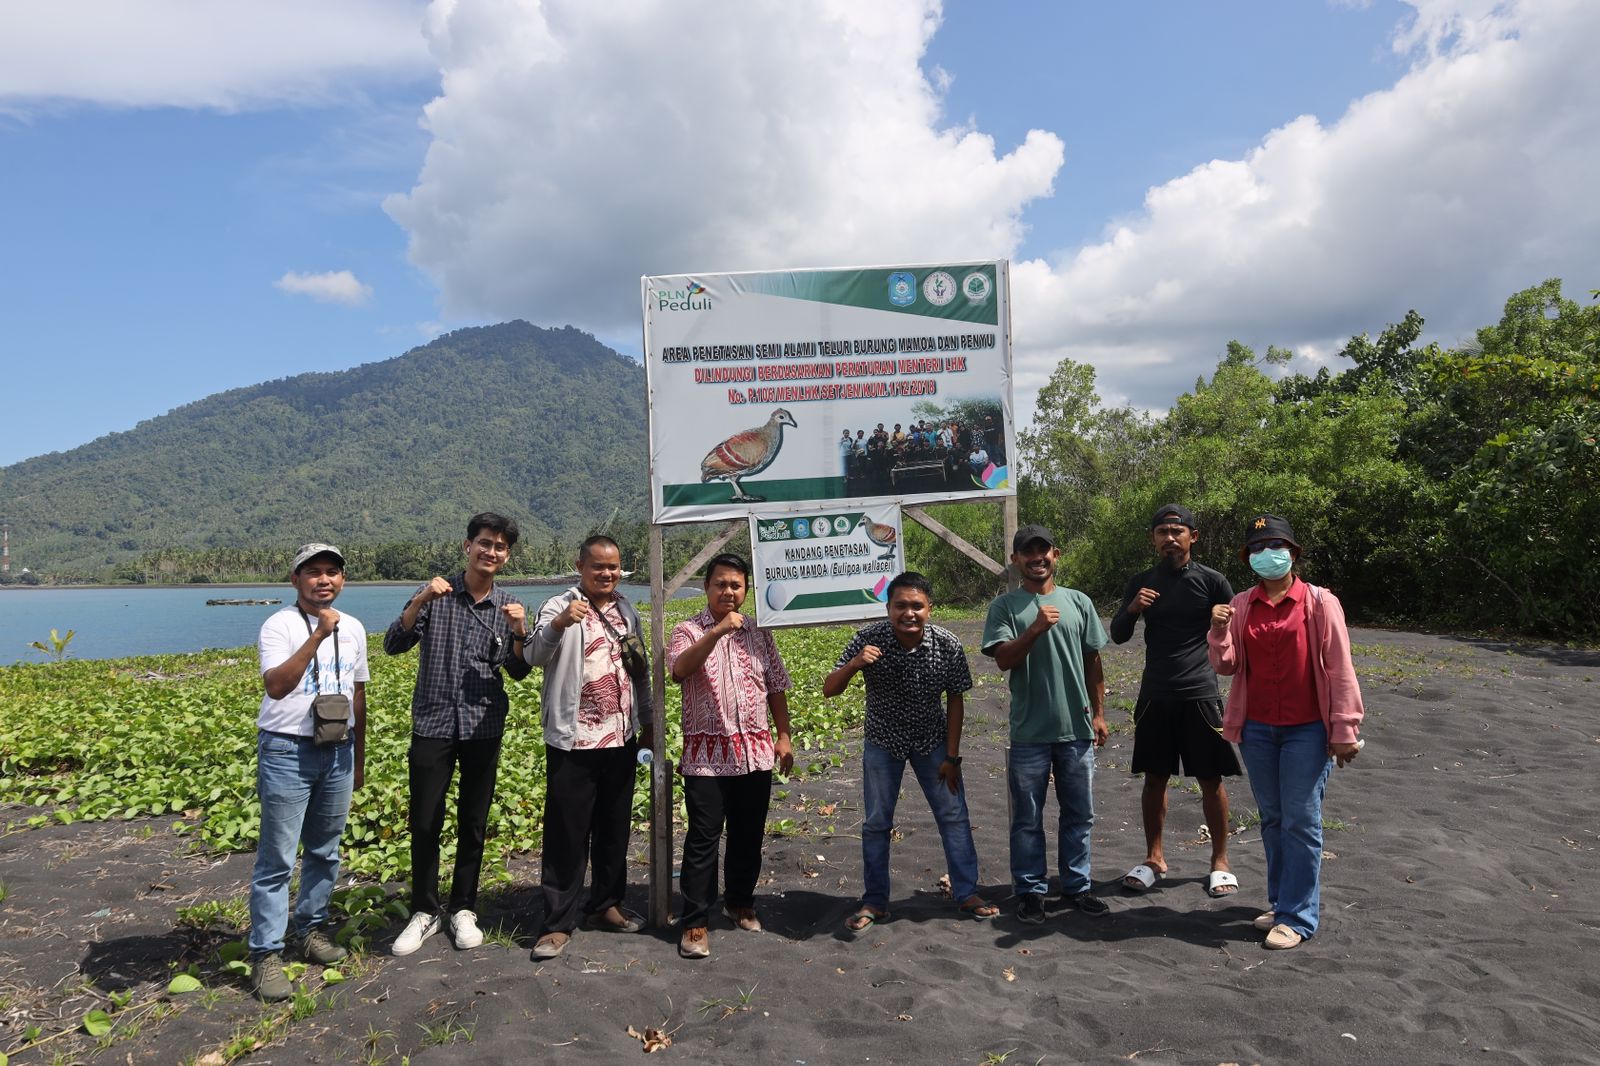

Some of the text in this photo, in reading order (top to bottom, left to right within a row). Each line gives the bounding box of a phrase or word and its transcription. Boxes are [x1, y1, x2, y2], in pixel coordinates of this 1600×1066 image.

[659, 290, 685, 300] PLN
[659, 297, 712, 311] Peduli
[662, 333, 995, 363] AREA PENETASAN SEMI ALAMI TELUR BURUNG MAMOA DAN PENYU
[694, 356, 967, 384] DILINDUNGI BERDASARKAN PERATURAN MENTERI LHK
[728, 388, 747, 405] No.
[785, 543, 870, 562] KANDANG PENETASAN
[765, 559, 895, 581] BURUNG MAMOA (Eulipoa wallacei)
